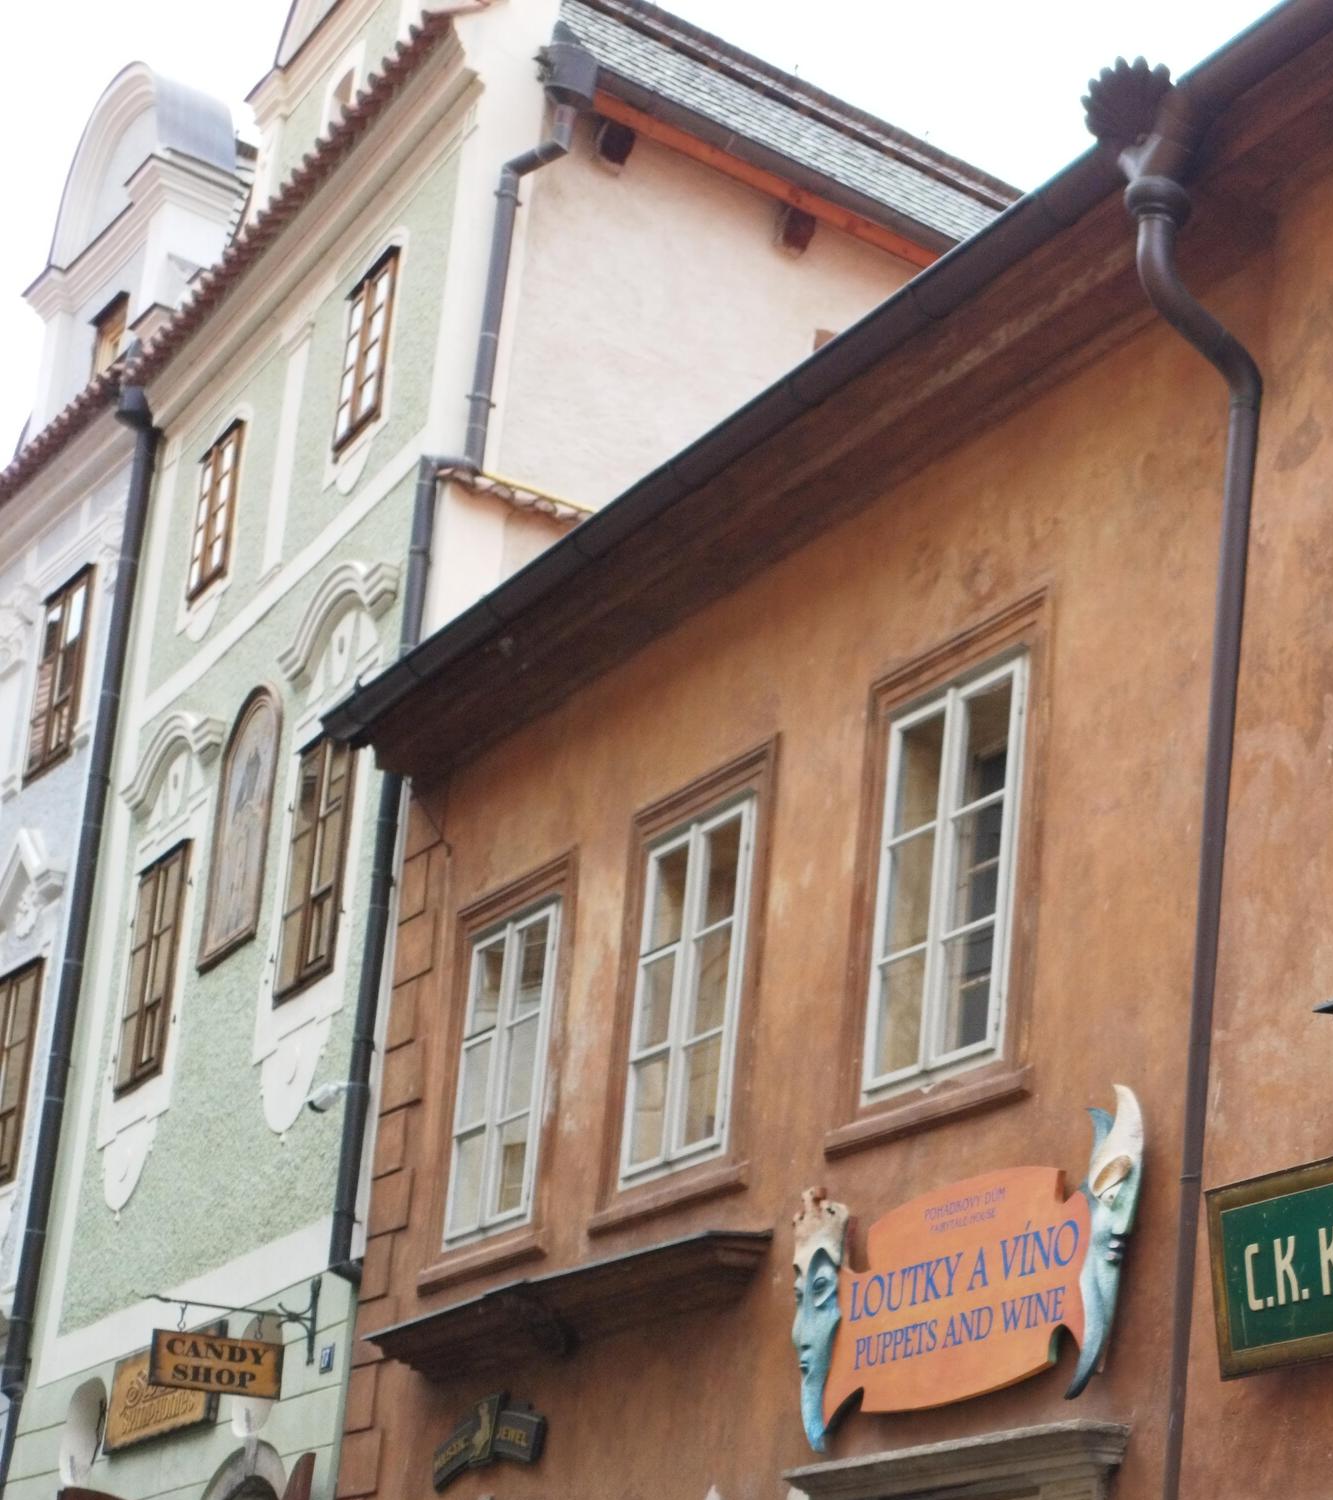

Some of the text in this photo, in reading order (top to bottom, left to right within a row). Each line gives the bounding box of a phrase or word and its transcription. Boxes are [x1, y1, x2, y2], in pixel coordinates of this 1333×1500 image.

[849, 1219, 1080, 1322] LOUTKY A VÍNO
[1244, 1234, 1310, 1312] C.K.
[166, 1337, 268, 1366] CANDY
[853, 1285, 1066, 1371] PUPPETS AND WINE
[172, 1363, 257, 1389] SHOP
